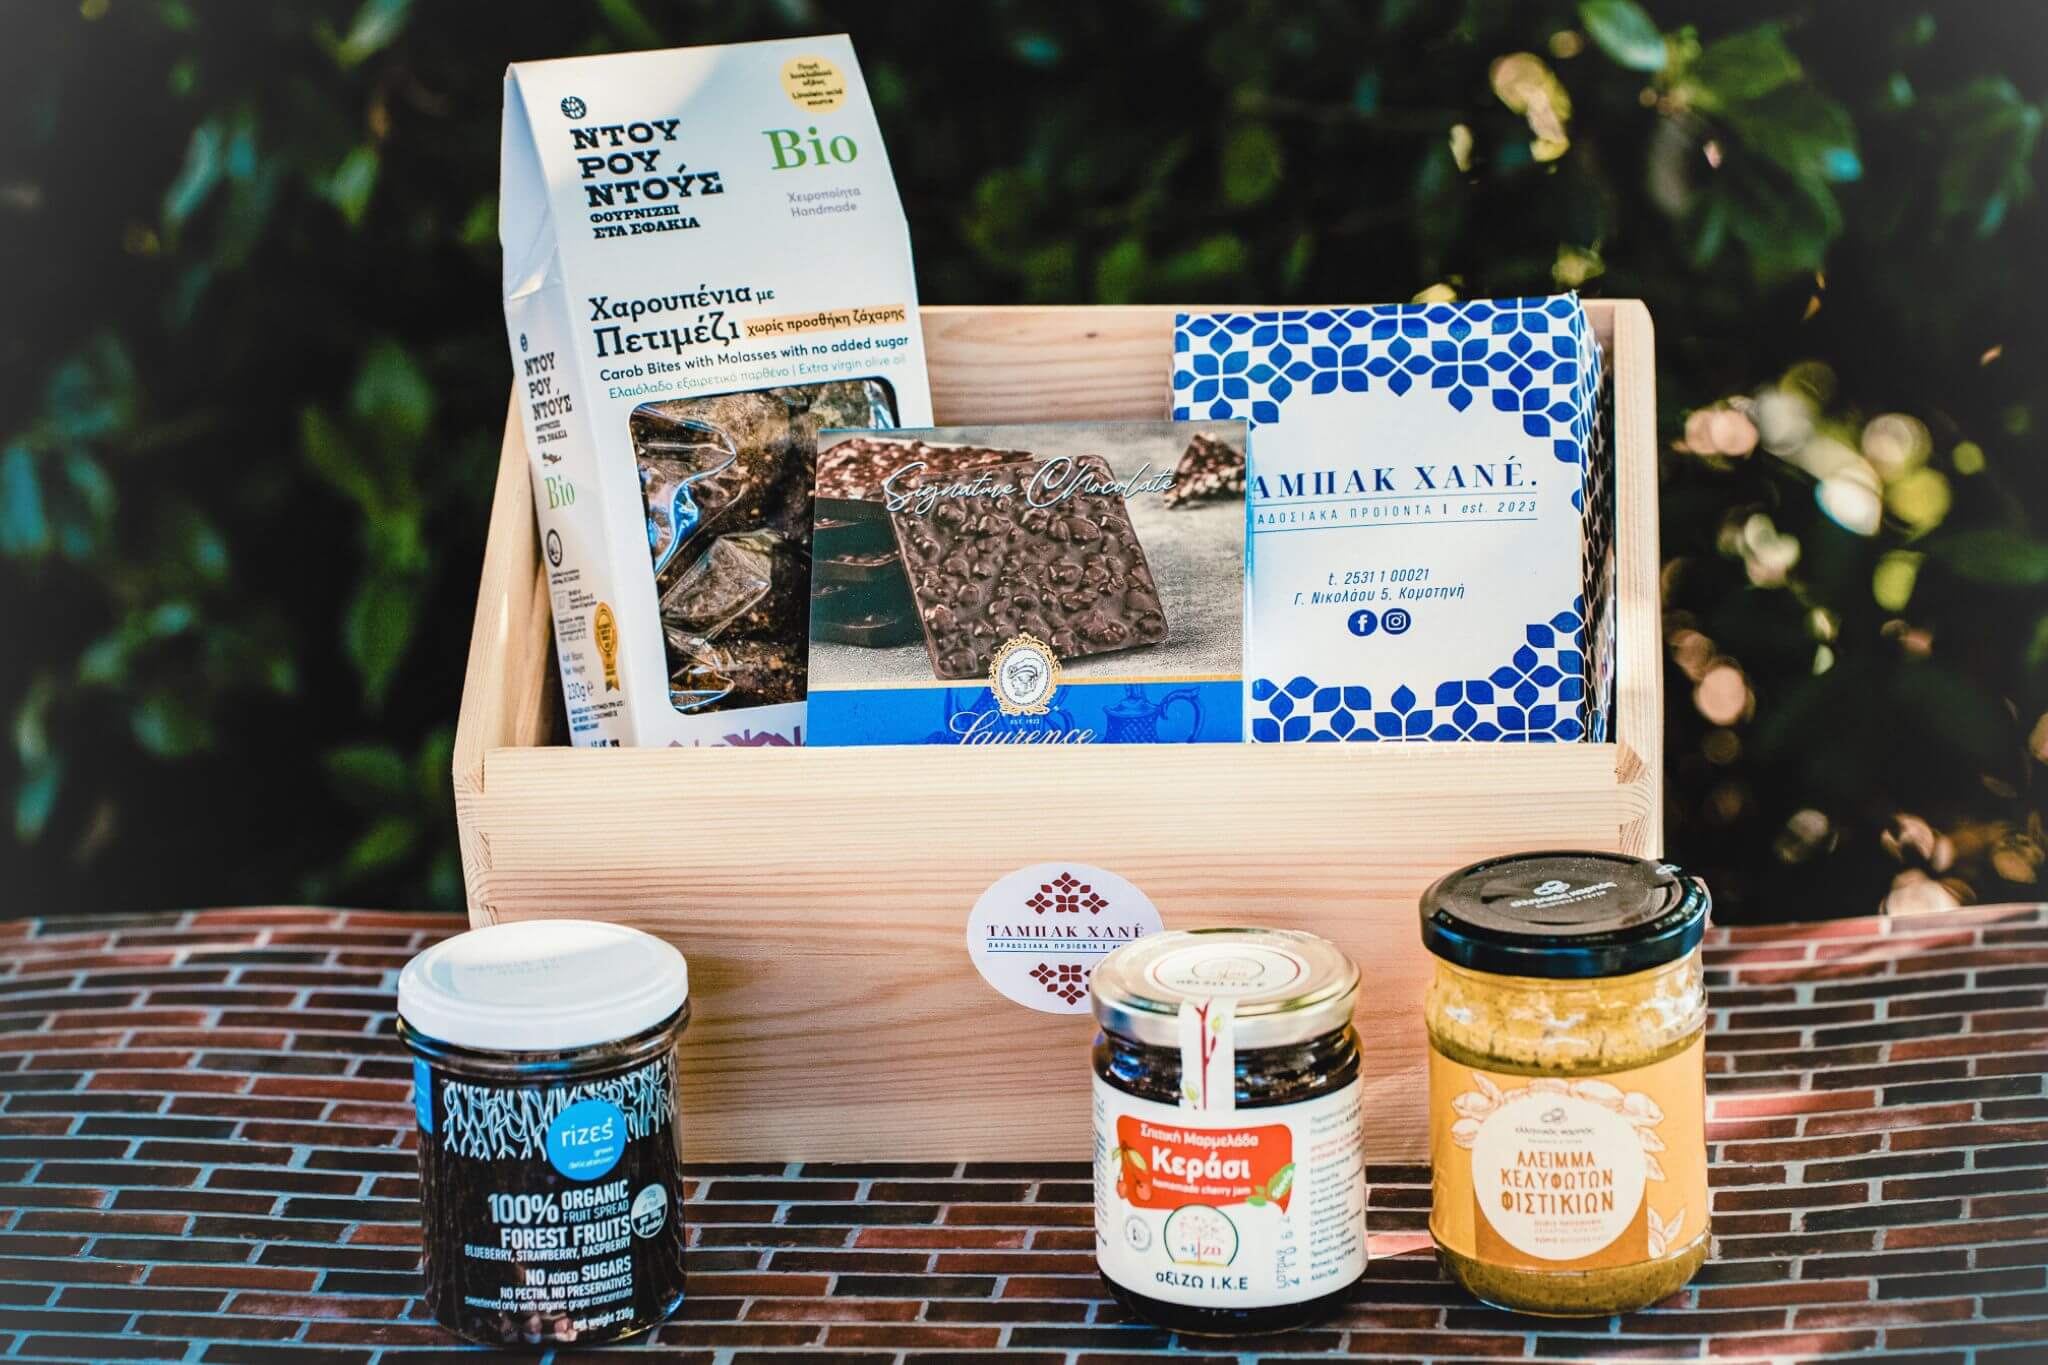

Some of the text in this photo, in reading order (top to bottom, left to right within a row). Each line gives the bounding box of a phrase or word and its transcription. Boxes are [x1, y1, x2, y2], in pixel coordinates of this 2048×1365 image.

[570, 118, 681, 149] ΝΤΟΥ
[762, 126, 857, 170] Bio
[577, 150, 661, 179] ΡΟΥ
[787, 186, 861, 203] Χειροποίητα
[590, 205, 680, 223] ΦΟΥΡΝΙΖΕΙ
[790, 202, 857, 218] Handmade
[593, 218, 700, 239] ΣΤΑ ΣΦΑΚΙΑ
[588, 285, 775, 322] Χαρουπένια με
[594, 307, 905, 358] Πετιμέζι χωρίς προσθήκη ζάχαρης
[599, 334, 909, 383] Carob Bites with Molasses with no added sugar
[528, 376, 552, 399] ΡΟΥ
[608, 381, 674, 399] Ελαιόλαδο
[741, 366, 790, 386] παρθένο
[799, 362, 829, 375] Extra
[831, 358, 862, 376] virgin
[544, 474, 576, 510] Bio
[881, 456, 1177, 516] Signature Chocolate
[1461, 501, 1489, 515] est.
[1497, 500, 1538, 514] 2023
[1344, 570, 1376, 585] 2531
[1379, 570, 1386, 583] 1
[1389, 568, 1431, 583] 00021
[1294, 592, 1306, 605] Γ.
[1311, 586, 1376, 605] Νικολάου
[1398, 583, 1466, 601] Κομοτηνή
[950, 709, 1098, 745] Laurence
[986, 925, 1079, 939] ΤΑΜΠΑΚ
[1140, 1122, 1259, 1150] Σπιτική Μαρμελάδα
[1152, 1145, 1251, 1185] Κεράσι
[1517, 1150, 1596, 1168] ΑΛΕΙΜΜΑ
[1152, 1177, 1252, 1197] homemade cherry jam
[1500, 1168, 1614, 1190] ΚΕΛΥΦΩΤΩΝ
[488, 1179, 630, 1225] 100% ORGANIC
[562, 1200, 630, 1223] FRUIT SPREAD
[1501, 1190, 1615, 1216] ΦΙΣΤΙΚΙΩΝ
[501, 1214, 631, 1250] FOREST FRUITS
[464, 1235, 631, 1264] BLUEBERRY, STRAWBERRY, RASPBERRY
[525, 1255, 632, 1286] NO ADDED SUGARS
[500, 1273, 633, 1301] NO PECTIN, NO PRESERVATIVES
[502, 1300, 519, 1314] only
[520, 1300, 538, 1312] with
[538, 1300, 567, 1313] organic
[568, 1298, 591, 1311] grape
